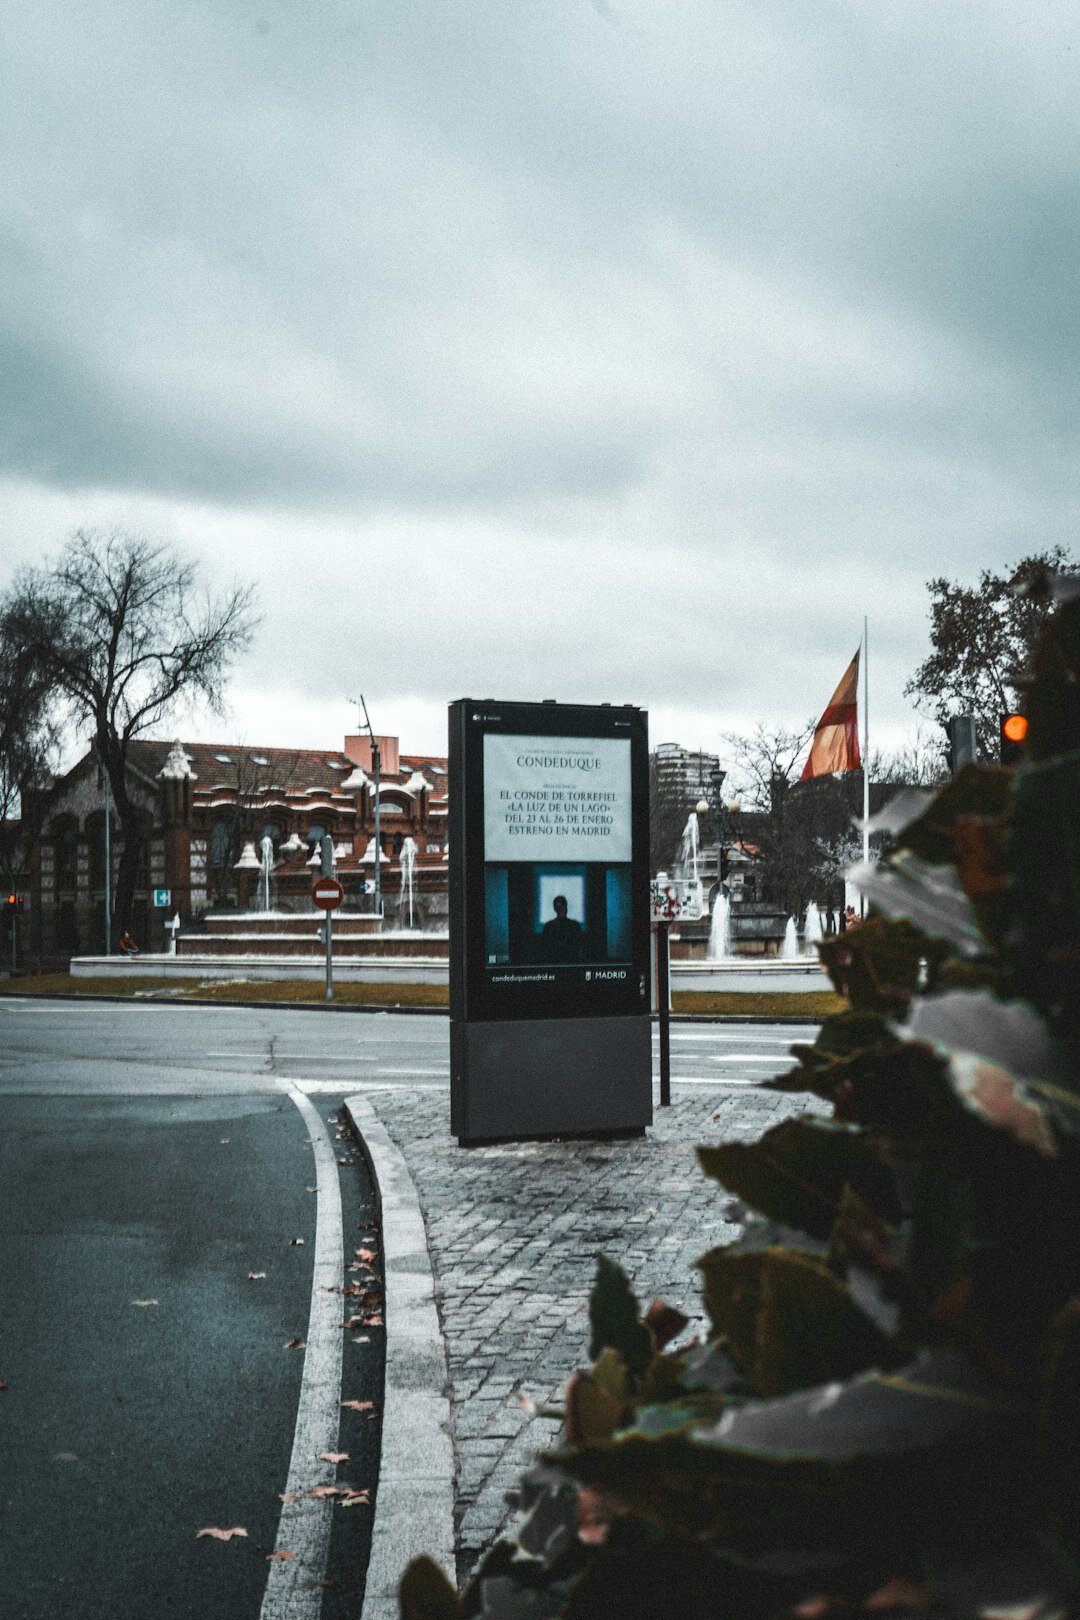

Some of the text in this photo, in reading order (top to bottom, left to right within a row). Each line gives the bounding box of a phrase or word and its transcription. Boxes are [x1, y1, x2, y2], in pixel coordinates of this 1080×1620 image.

[516, 756, 602, 771] CONDEDUQUE
[500, 790, 617, 802] EL CONDE DE TORREFIEL
[527, 803, 546, 812] LUZ
[548, 803, 562, 812] DE
[564, 804, 578, 813] UN
[505, 814, 614, 825] DEL 23 AL 26 DE ENERO
[508, 826, 611, 836] ESTRENO EN MADRID
[491, 973, 556, 983] condeduquemadrid.es
[594, 971, 627, 980] MADRID
